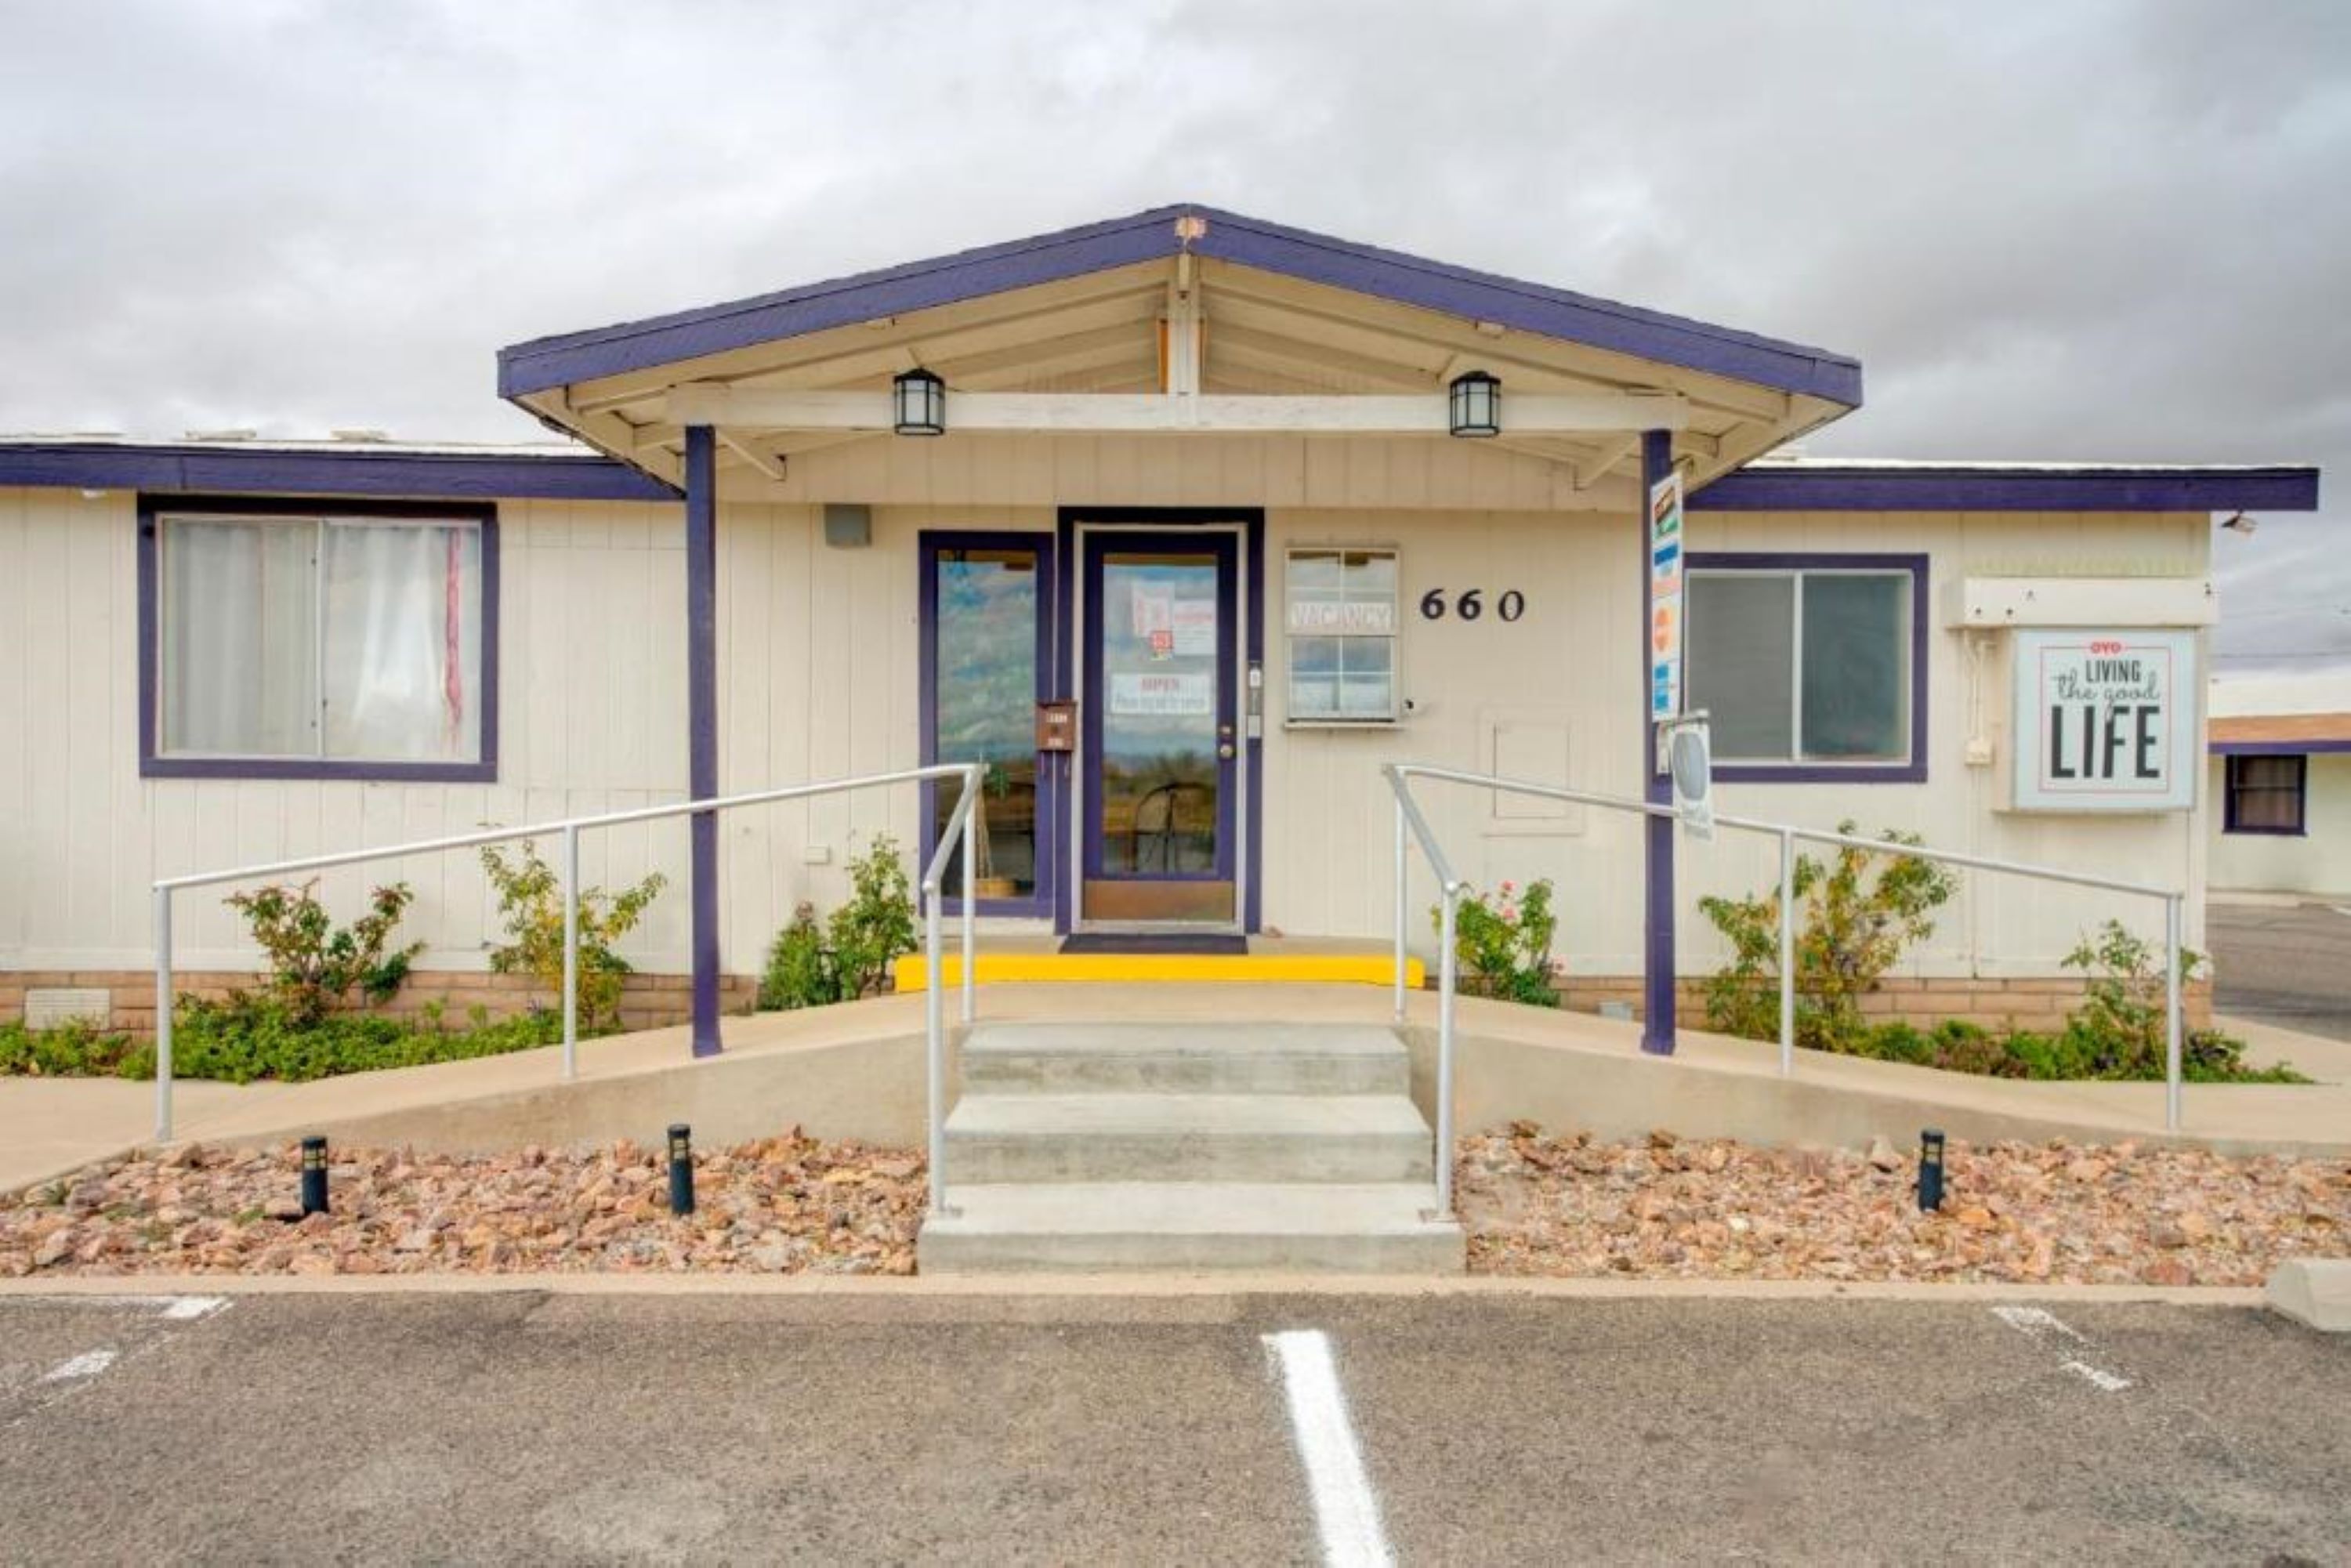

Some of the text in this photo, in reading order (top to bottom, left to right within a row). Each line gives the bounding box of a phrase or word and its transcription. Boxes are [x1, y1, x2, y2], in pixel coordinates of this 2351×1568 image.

[1420, 588, 1525, 622] 660
[2089, 641, 2122, 654] OYO
[2086, 660, 2142, 683] LIVING
[2051, 669, 2160, 723] the good
[2051, 705, 2161, 778] LIFE
